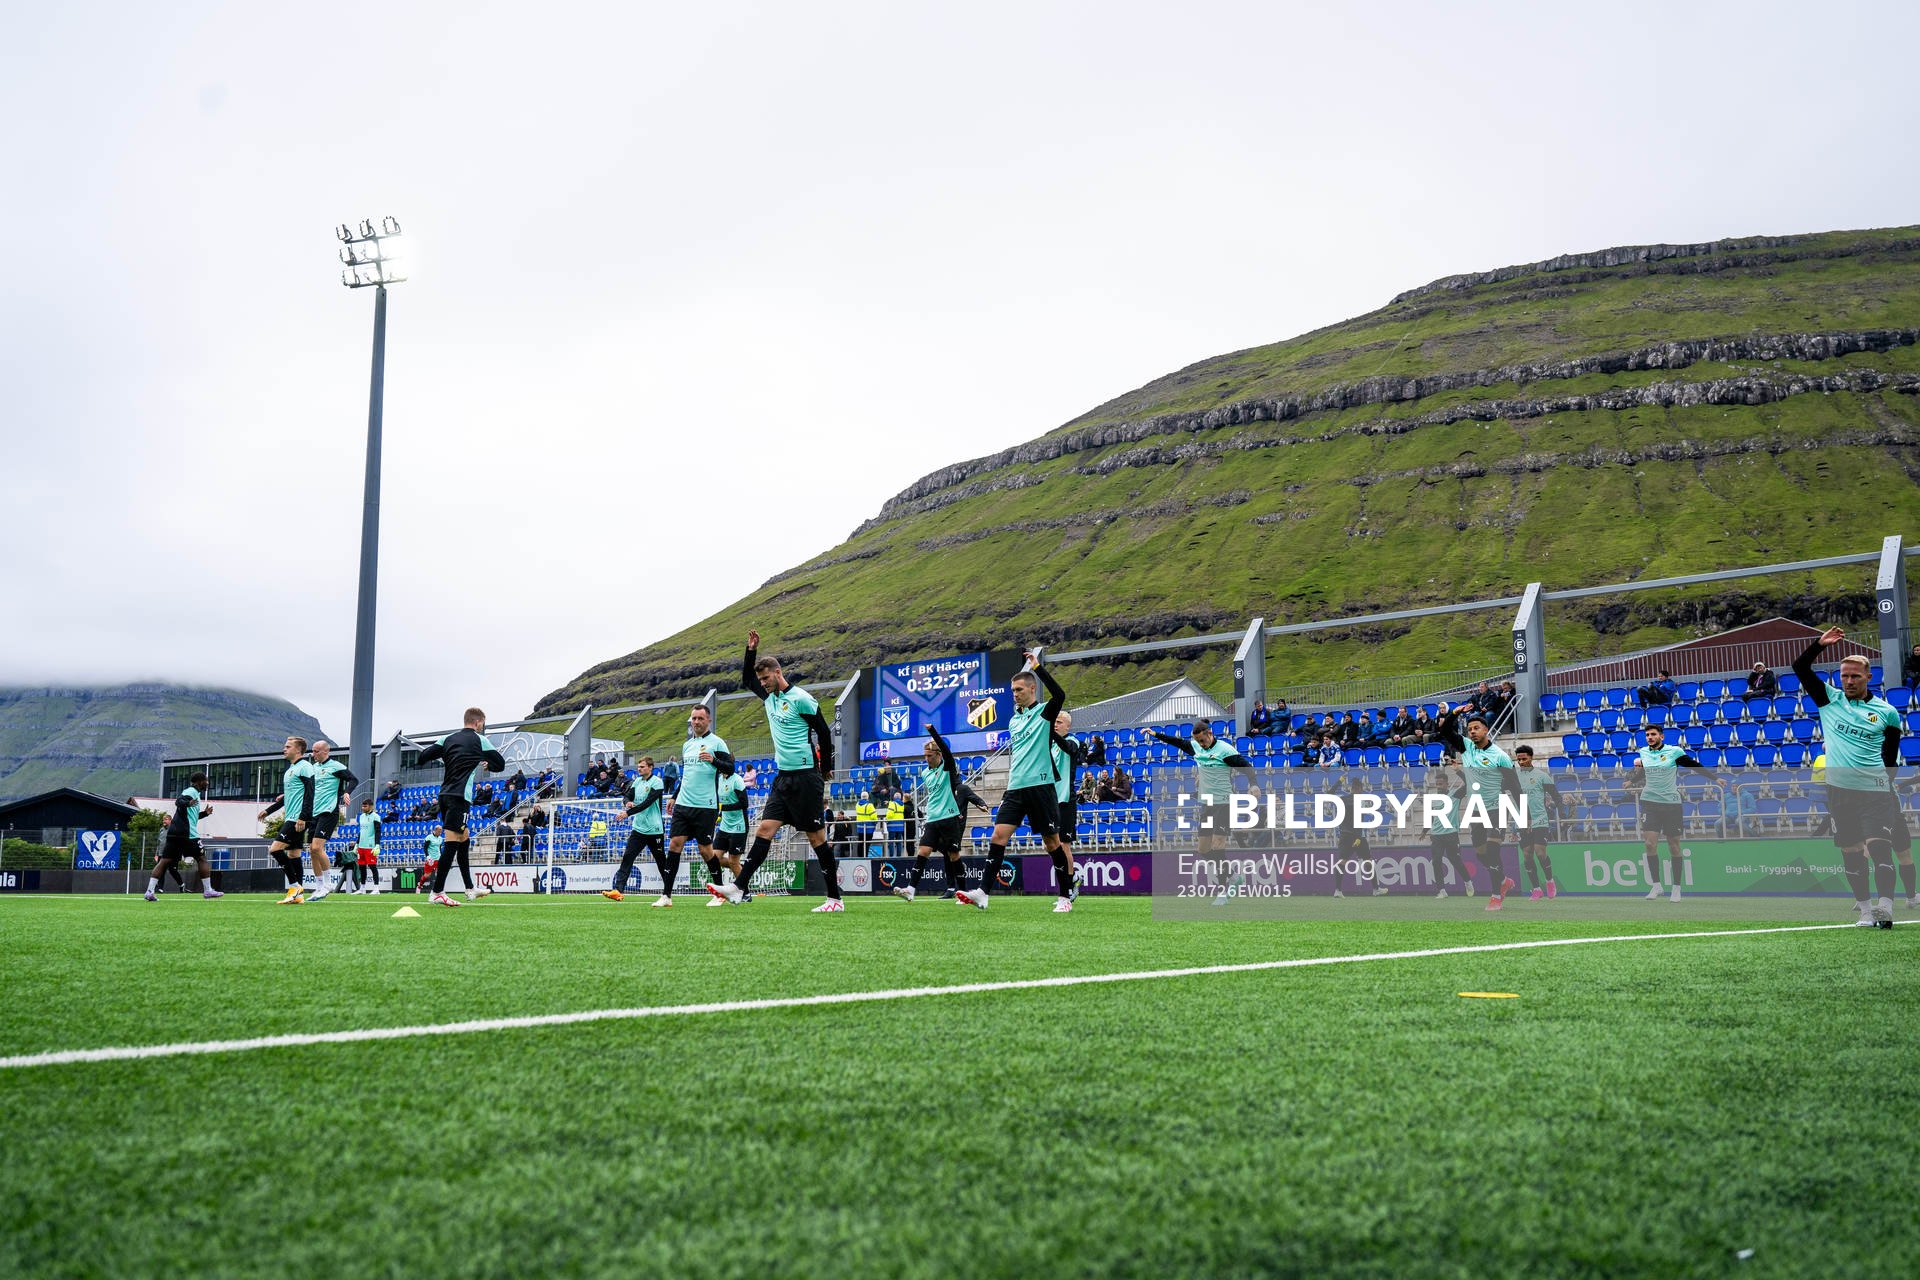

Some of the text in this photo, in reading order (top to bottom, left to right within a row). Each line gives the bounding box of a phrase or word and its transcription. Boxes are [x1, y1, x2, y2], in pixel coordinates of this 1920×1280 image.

[898, 666, 910, 677] KÍ
[918, 665, 934, 675] BK
[936, 660, 980, 673] Häcken
[906, 672, 969, 692] 0:32:21
[959, 687, 1005, 698] BK Häcken
[802, 757, 807, 766] 3
[1039, 773, 1047, 781] 17
[89, 834, 109, 853] KÍ
[882, 871, 894, 879] TSK
[1000, 869, 1013, 878] TSK
[1725, 865, 1752, 874] Banki
[1759, 865, 1802, 876] Trygging
[475, 872, 518, 887] TOYOTA
